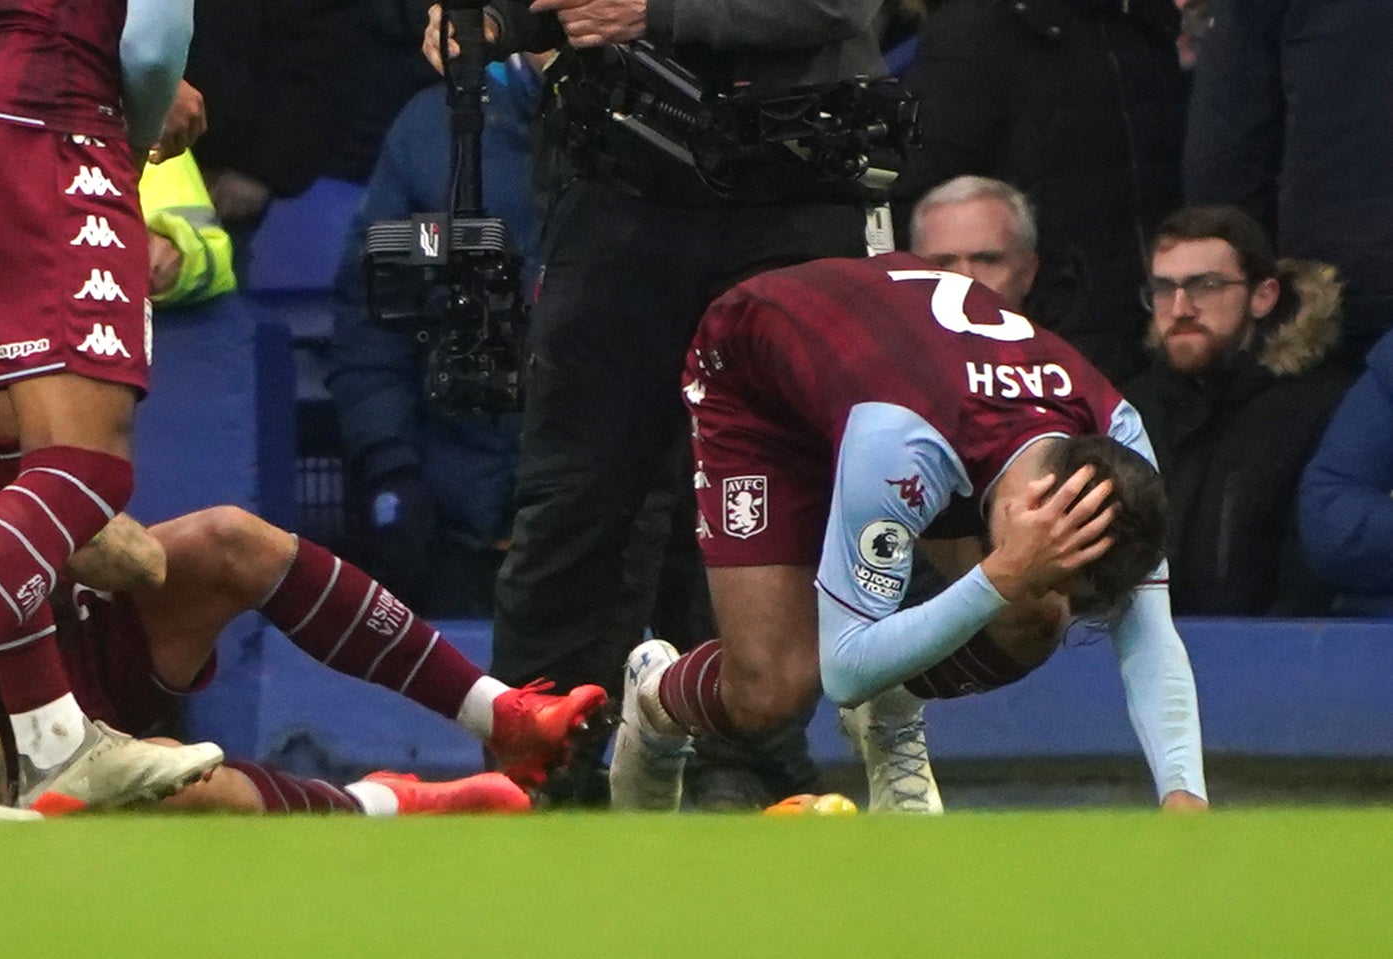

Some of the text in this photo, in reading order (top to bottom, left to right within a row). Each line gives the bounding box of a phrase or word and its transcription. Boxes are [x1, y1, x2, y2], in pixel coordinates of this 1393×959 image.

[887, 270, 1035, 341] 2
[966, 361, 1072, 399] CASH
[727, 478, 764, 492] AVFC
[871, 572, 901, 589] room
